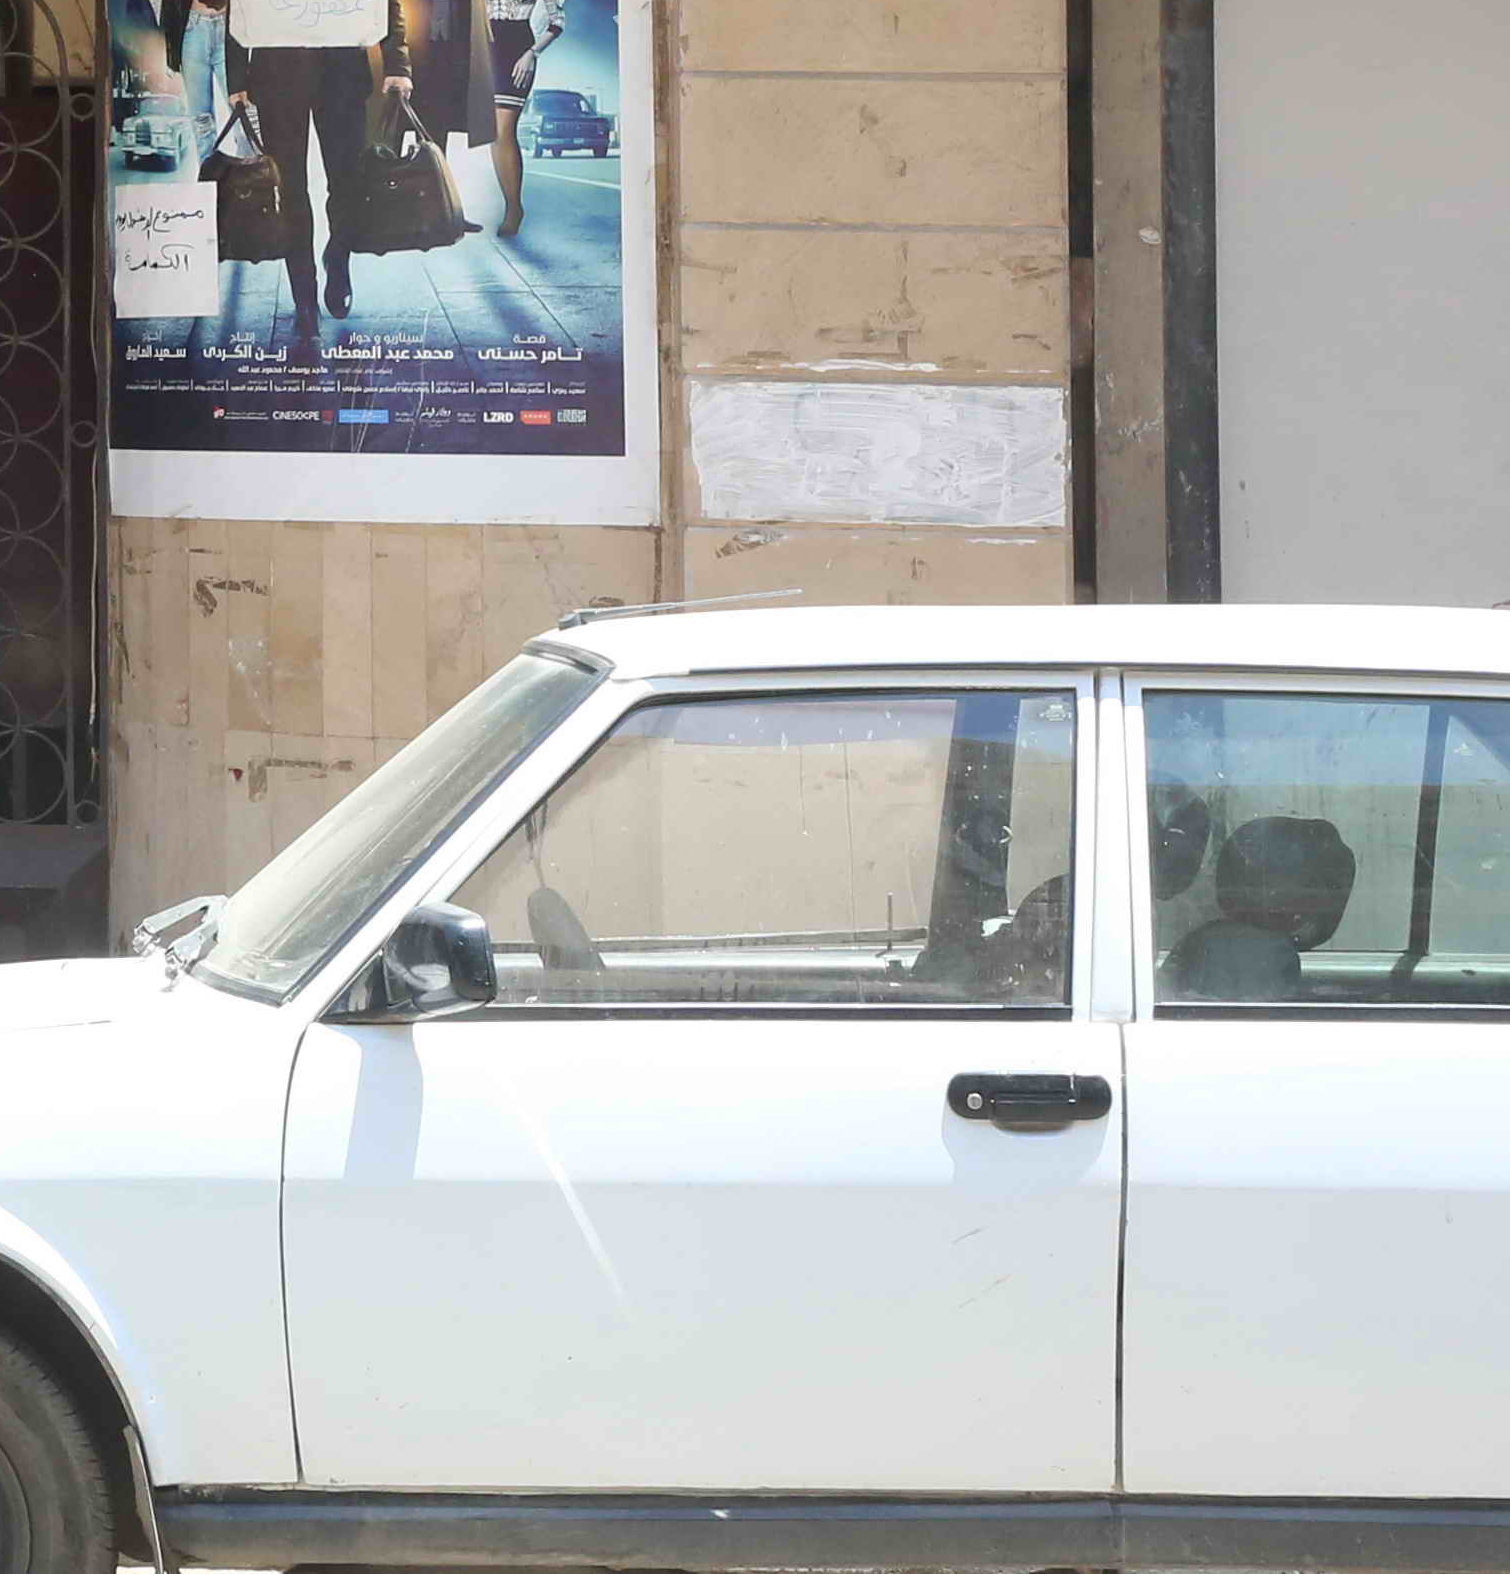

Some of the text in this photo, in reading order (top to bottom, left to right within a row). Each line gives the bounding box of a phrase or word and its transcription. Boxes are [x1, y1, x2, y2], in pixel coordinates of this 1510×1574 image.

[153, 209, 205, 233] ممنوع
[124, 243, 196, 272] الكمامة
[348, 331, 424, 345] سيناريو و حوار
[153, 346, 187, 361] سعيد
[385, 347, 412, 363] عبد
[413, 347, 454, 361] محمد
[540, 347, 583, 364] تامر
[483, 411, 514, 423] LZRD
